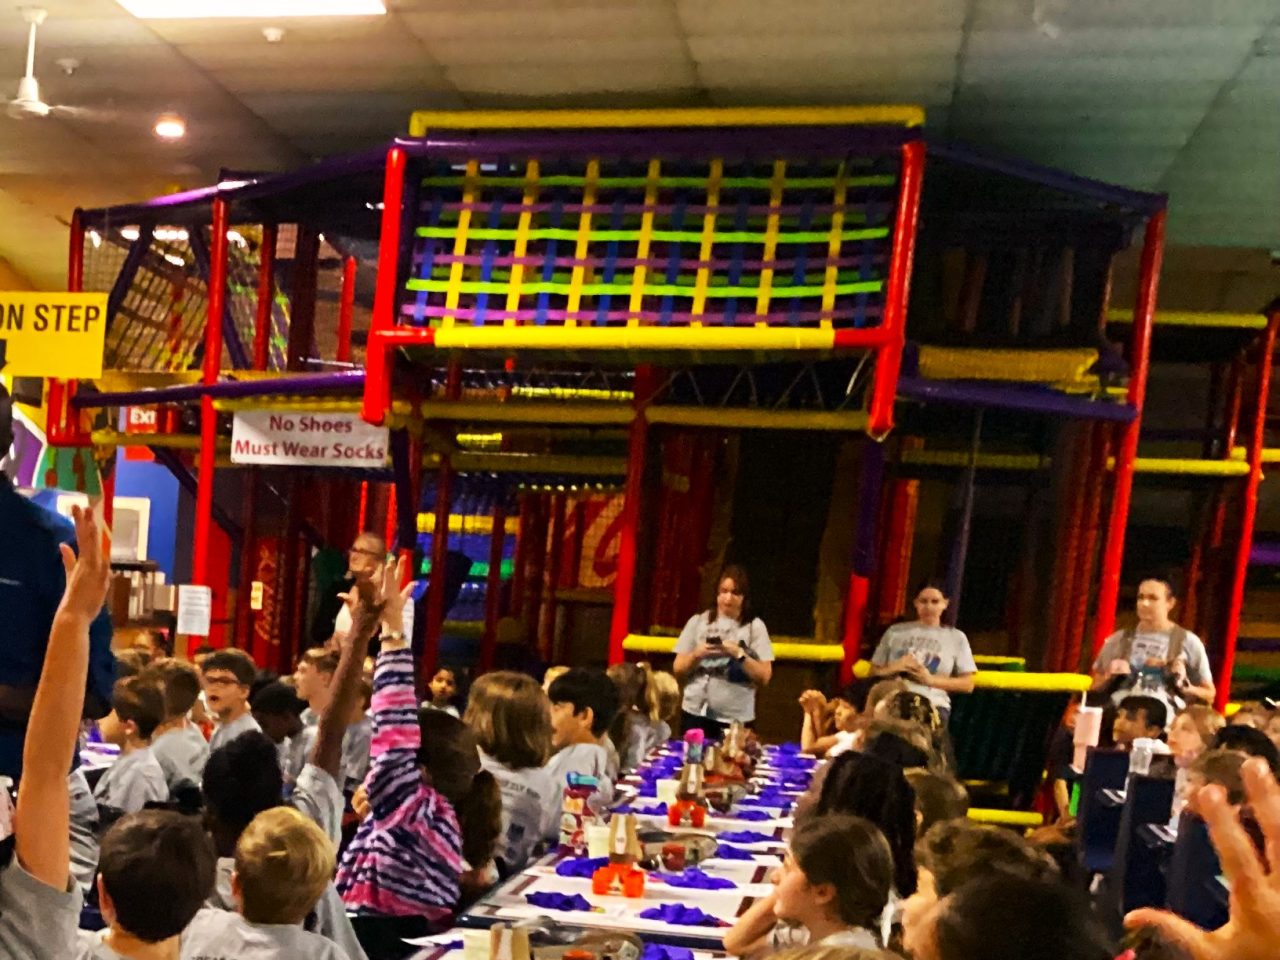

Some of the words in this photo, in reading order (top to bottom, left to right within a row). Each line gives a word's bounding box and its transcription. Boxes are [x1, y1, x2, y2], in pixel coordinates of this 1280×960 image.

[33, 304, 100, 332] STEP
[271, 415, 294, 431] No
[299, 416, 353, 433] Shoes
[235, 439, 278, 455] Must
[282, 441, 329, 458] Wear
[333, 443, 384, 460] Socks
